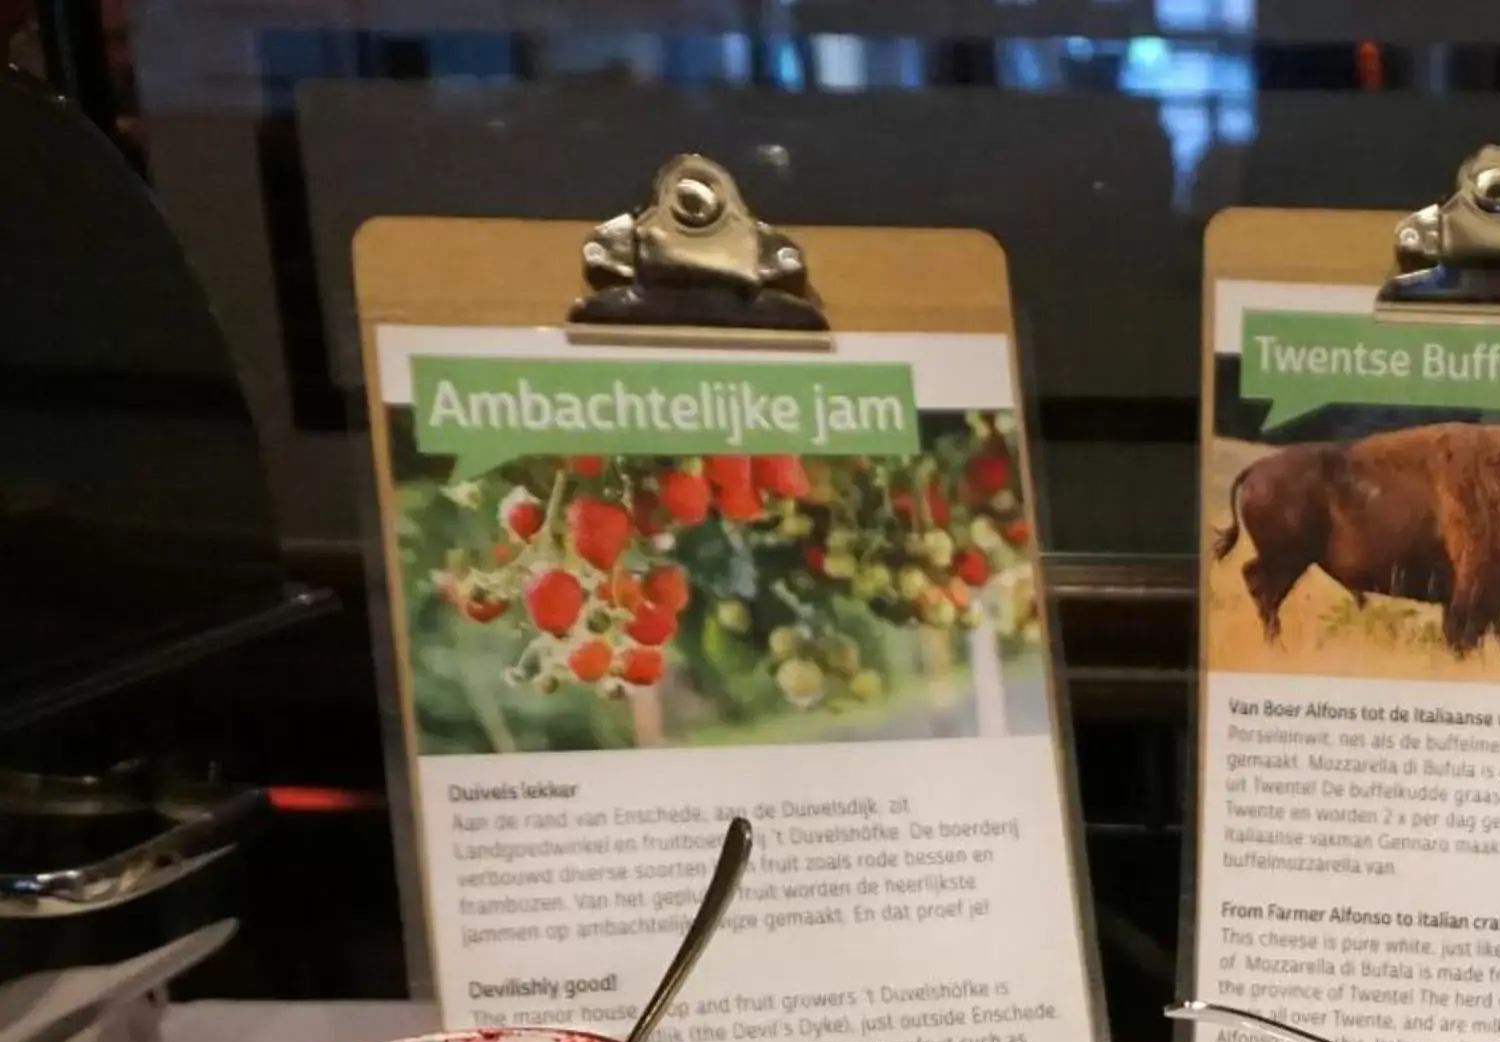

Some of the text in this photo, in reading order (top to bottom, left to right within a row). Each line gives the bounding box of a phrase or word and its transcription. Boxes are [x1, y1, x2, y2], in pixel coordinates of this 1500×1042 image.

[1254, 336, 1411, 377] Twentse
[429, 378, 904, 446] Ambachtelijke jam
[1229, 699, 1259, 718] Van
[1263, 700, 1302, 719] Boer
[1304, 702, 1358, 722] Alfons
[1361, 706, 1386, 723] tot
[1389, 705, 1409, 724] de
[1414, 706, 1493, 727] Italiaanse
[1221, 903, 1263, 921] From
[1267, 904, 1326, 924] Farmer
[1329, 907, 1392, 927] Alfonso
[1396, 912, 1413, 928] to
[1417, 911, 1469, 930] Italian
[468, 975, 618, 999] Devilishly good!
